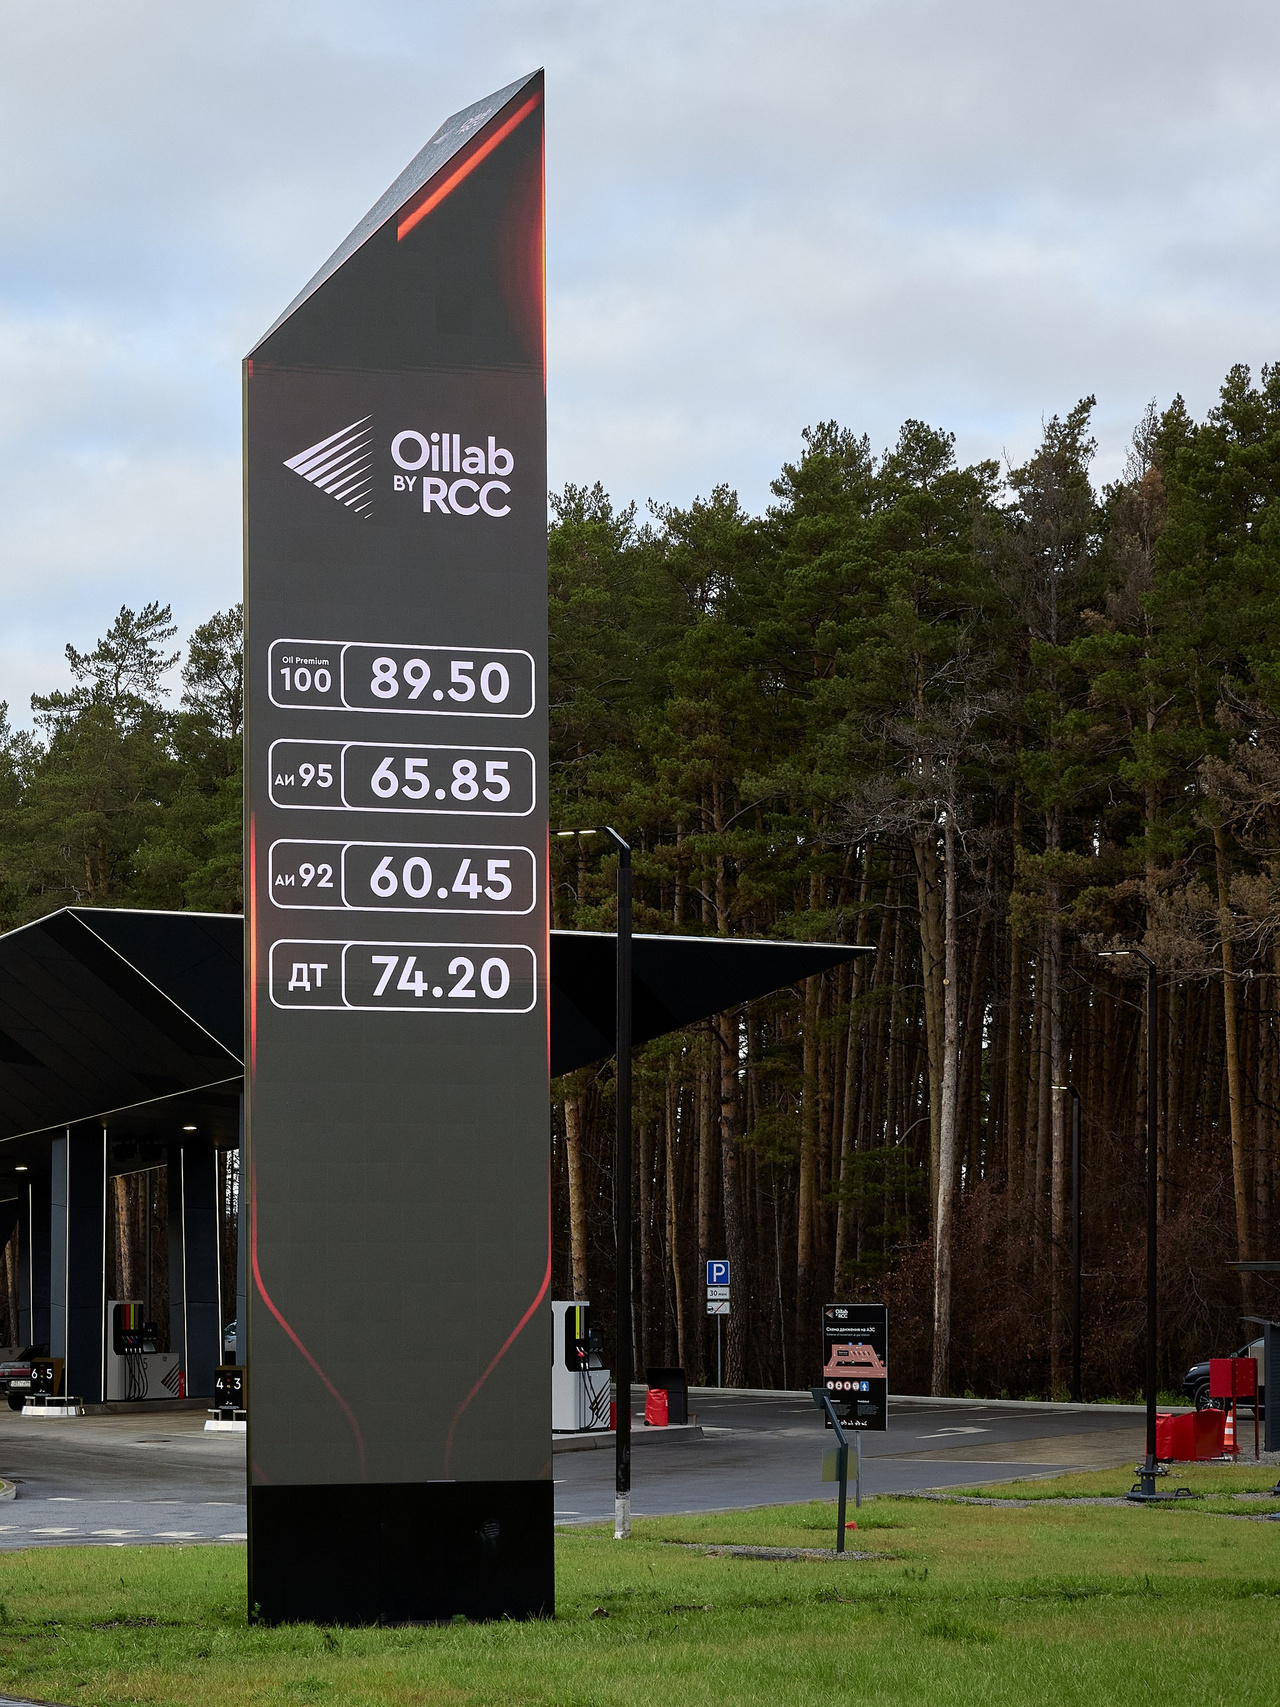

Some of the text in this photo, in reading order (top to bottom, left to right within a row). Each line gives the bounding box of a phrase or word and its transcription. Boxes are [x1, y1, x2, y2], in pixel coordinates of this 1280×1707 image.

[391, 430, 514, 476] Oillab
[393, 475, 417, 492] BY
[422, 477, 512, 517] RCC
[295, 657, 329, 665] Premium
[280, 667, 331, 692] 100
[370, 657, 510, 703] 89.50
[298, 763, 333, 788] 95
[370, 757, 511, 802] 65.85
[298, 863, 334, 888] 92
[370, 856, 512, 901] 60.45
[288, 963, 328, 992] ДТ
[371, 955, 511, 999] 74.20
[713, 1264, 725, 1282] P
[709, 1289, 718, 1297] 30
[31, 1368, 53, 1379] 6 5
[216, 1377, 242, 1390] 4 3
